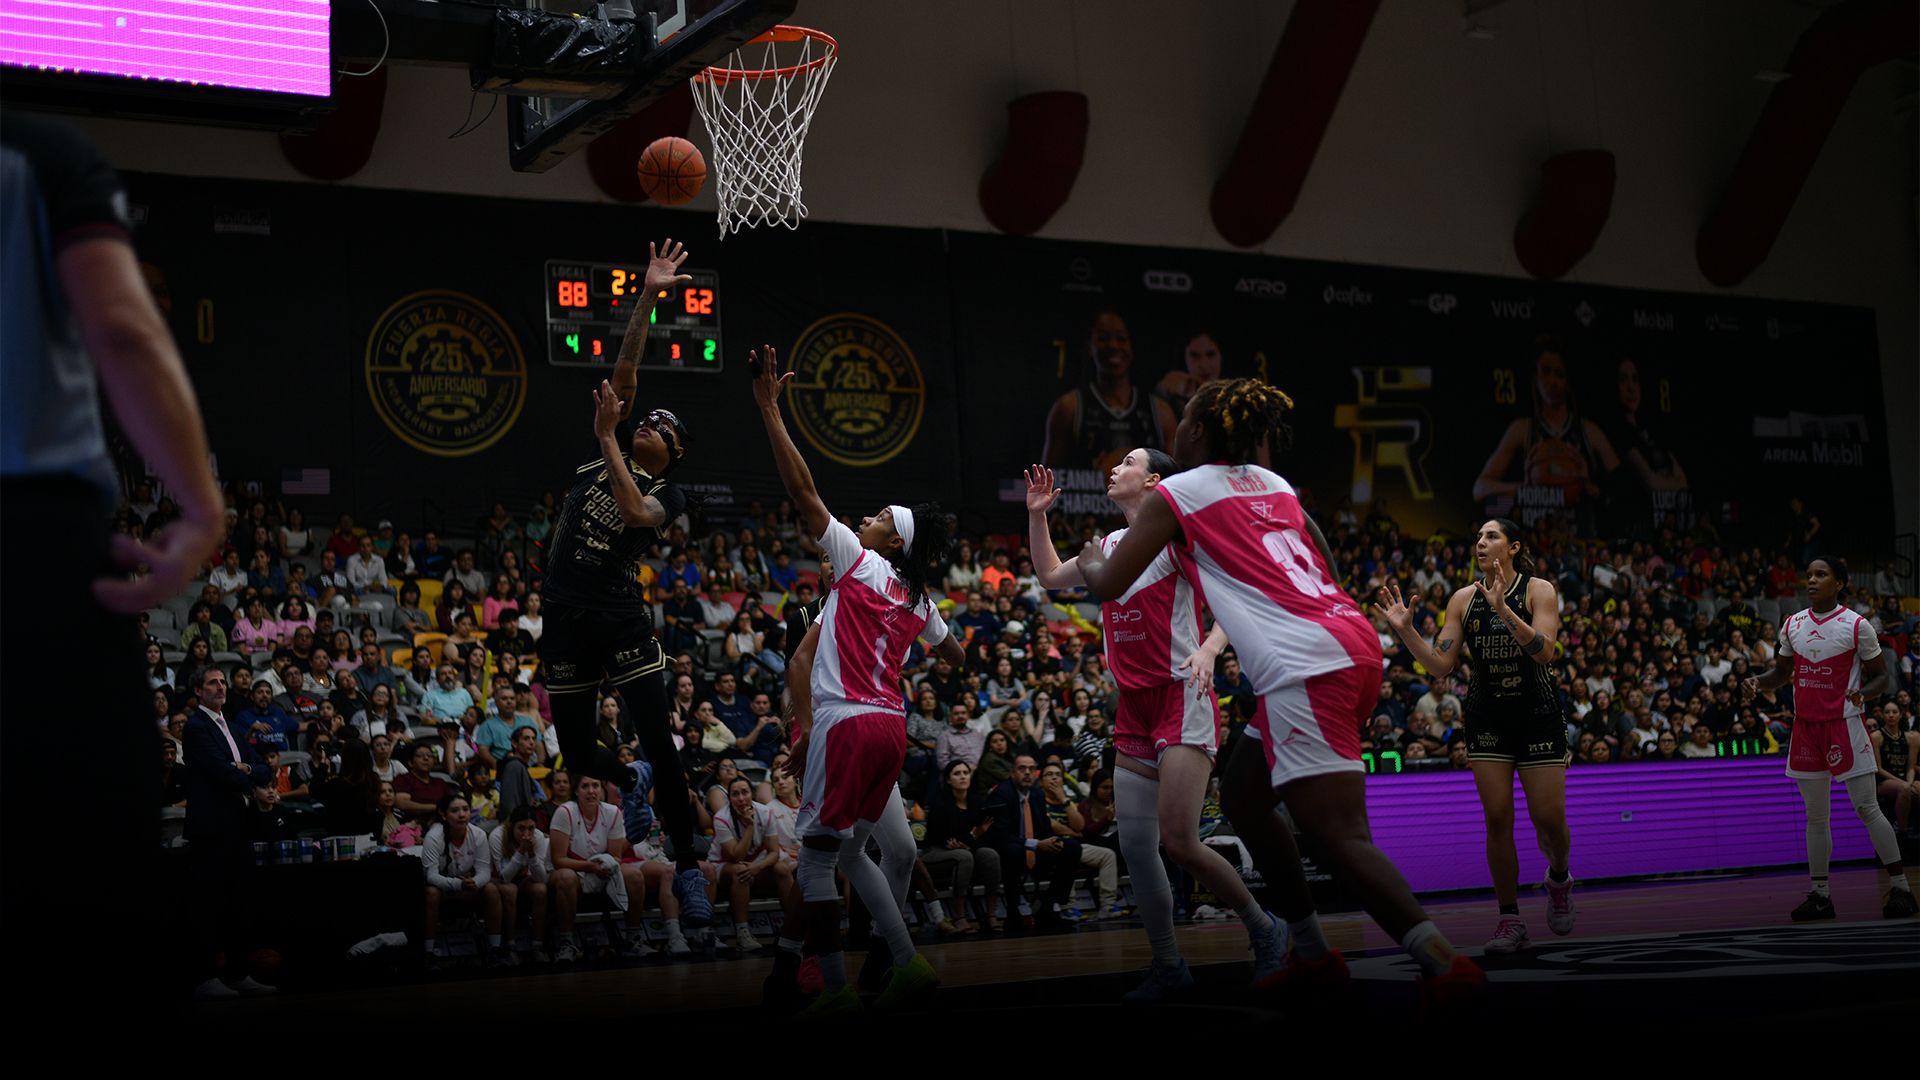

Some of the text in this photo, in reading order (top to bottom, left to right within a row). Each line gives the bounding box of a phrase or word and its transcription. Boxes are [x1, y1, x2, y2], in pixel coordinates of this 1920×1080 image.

[558, 281, 588, 308] 88
[1234, 277, 1287, 296] ATRO
[684, 288, 714, 315] 62
[1428, 292, 1457, 314] GP
[385, 305, 447, 356] FUERZA
[1632, 308, 1675, 332] Mobil
[565, 333, 580, 354] 4
[592, 340, 603, 356] 3
[671, 343, 681, 360] 3
[703, 339, 717, 362] 2
[429, 341, 463, 372] 25
[1050, 337, 1069, 380] 7
[409, 374, 488, 398] ANIVERSARIO
[841, 360, 871, 389] 25
[1491, 368, 1518, 406] 23
[1657, 376, 1672, 413] 8
[1762, 440, 1864, 466] ARENA Mobil
[1053, 468, 1104, 490] EANNA
[582, 500, 626, 534] REGIA
[1111, 609, 1142, 623] BYD
[1475, 634, 1518, 648] FUERZ
[1482, 646, 1523, 659] REGIA
[872, 633, 888, 690] 1
[1489, 662, 1519, 674] Mobil
[1799, 665, 1832, 675] BYD
[1501, 676, 1523, 688] GP
